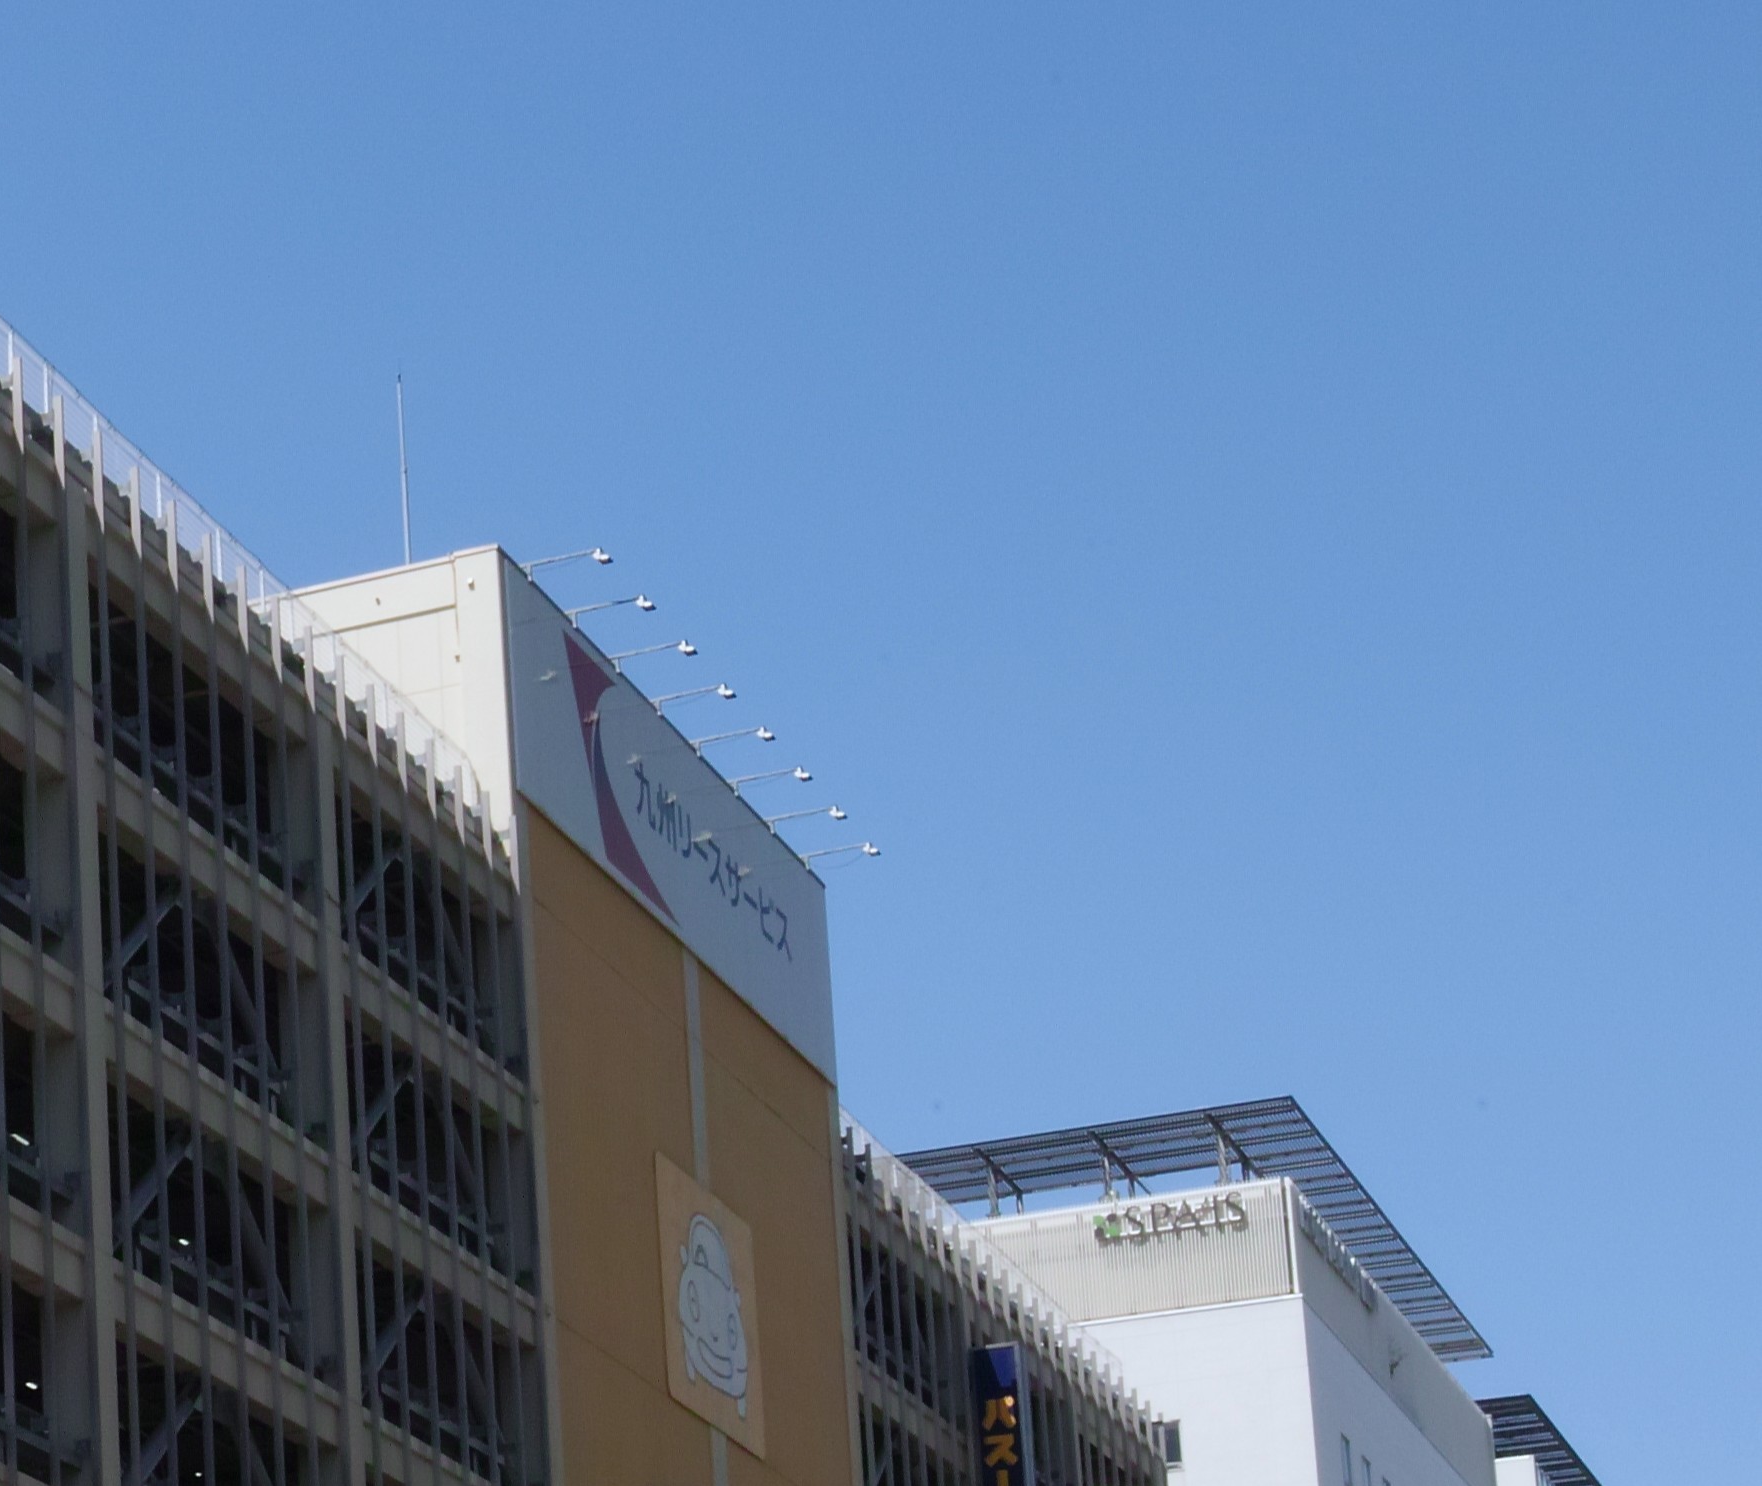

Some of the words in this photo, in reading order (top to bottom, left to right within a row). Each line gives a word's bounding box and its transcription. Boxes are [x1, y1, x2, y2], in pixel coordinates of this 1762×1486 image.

[633, 761, 793, 964] 九州リースサービス
